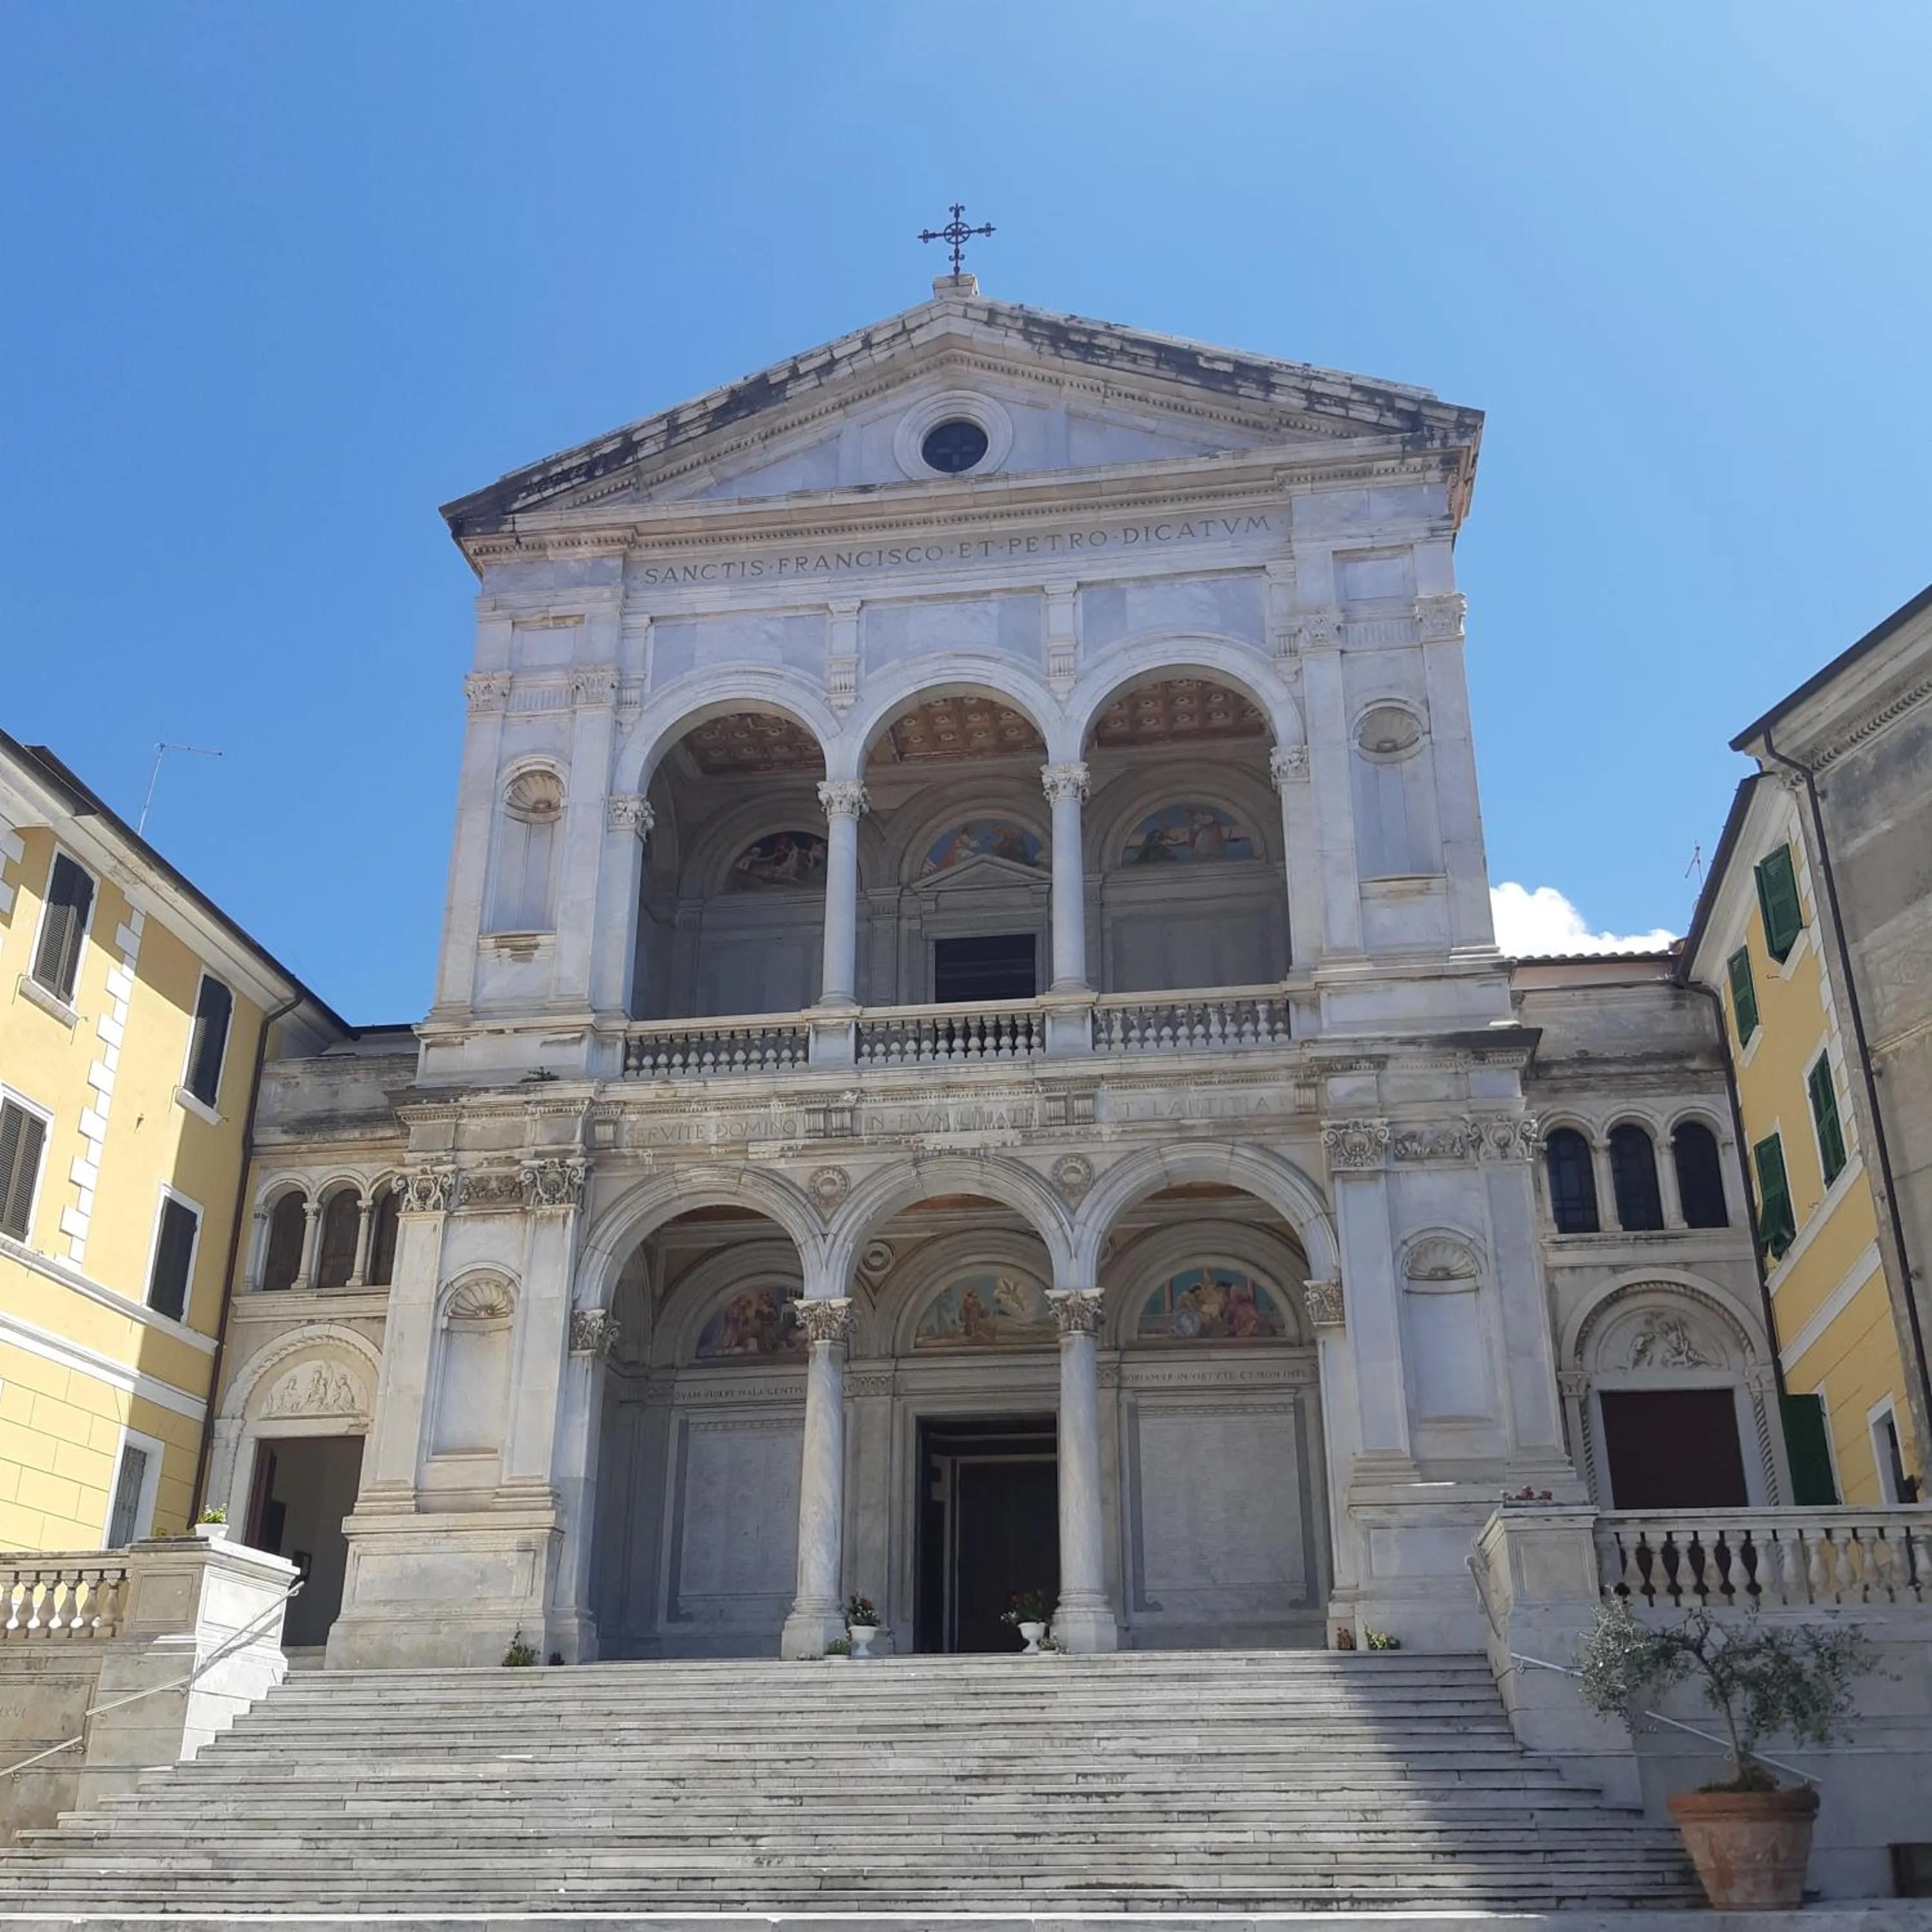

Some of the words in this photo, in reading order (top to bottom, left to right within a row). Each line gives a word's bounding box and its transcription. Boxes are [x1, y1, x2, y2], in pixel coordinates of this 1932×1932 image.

[645, 559, 764, 585] SANCTIS
[777, 545, 944, 575] FRANCISCO
[959, 540, 997, 558] ET
[1008, 529, 1108, 554] PETRO
[1123, 515, 1273, 545] DICATVM
[715, 1119, 797, 1139] DOMINO
